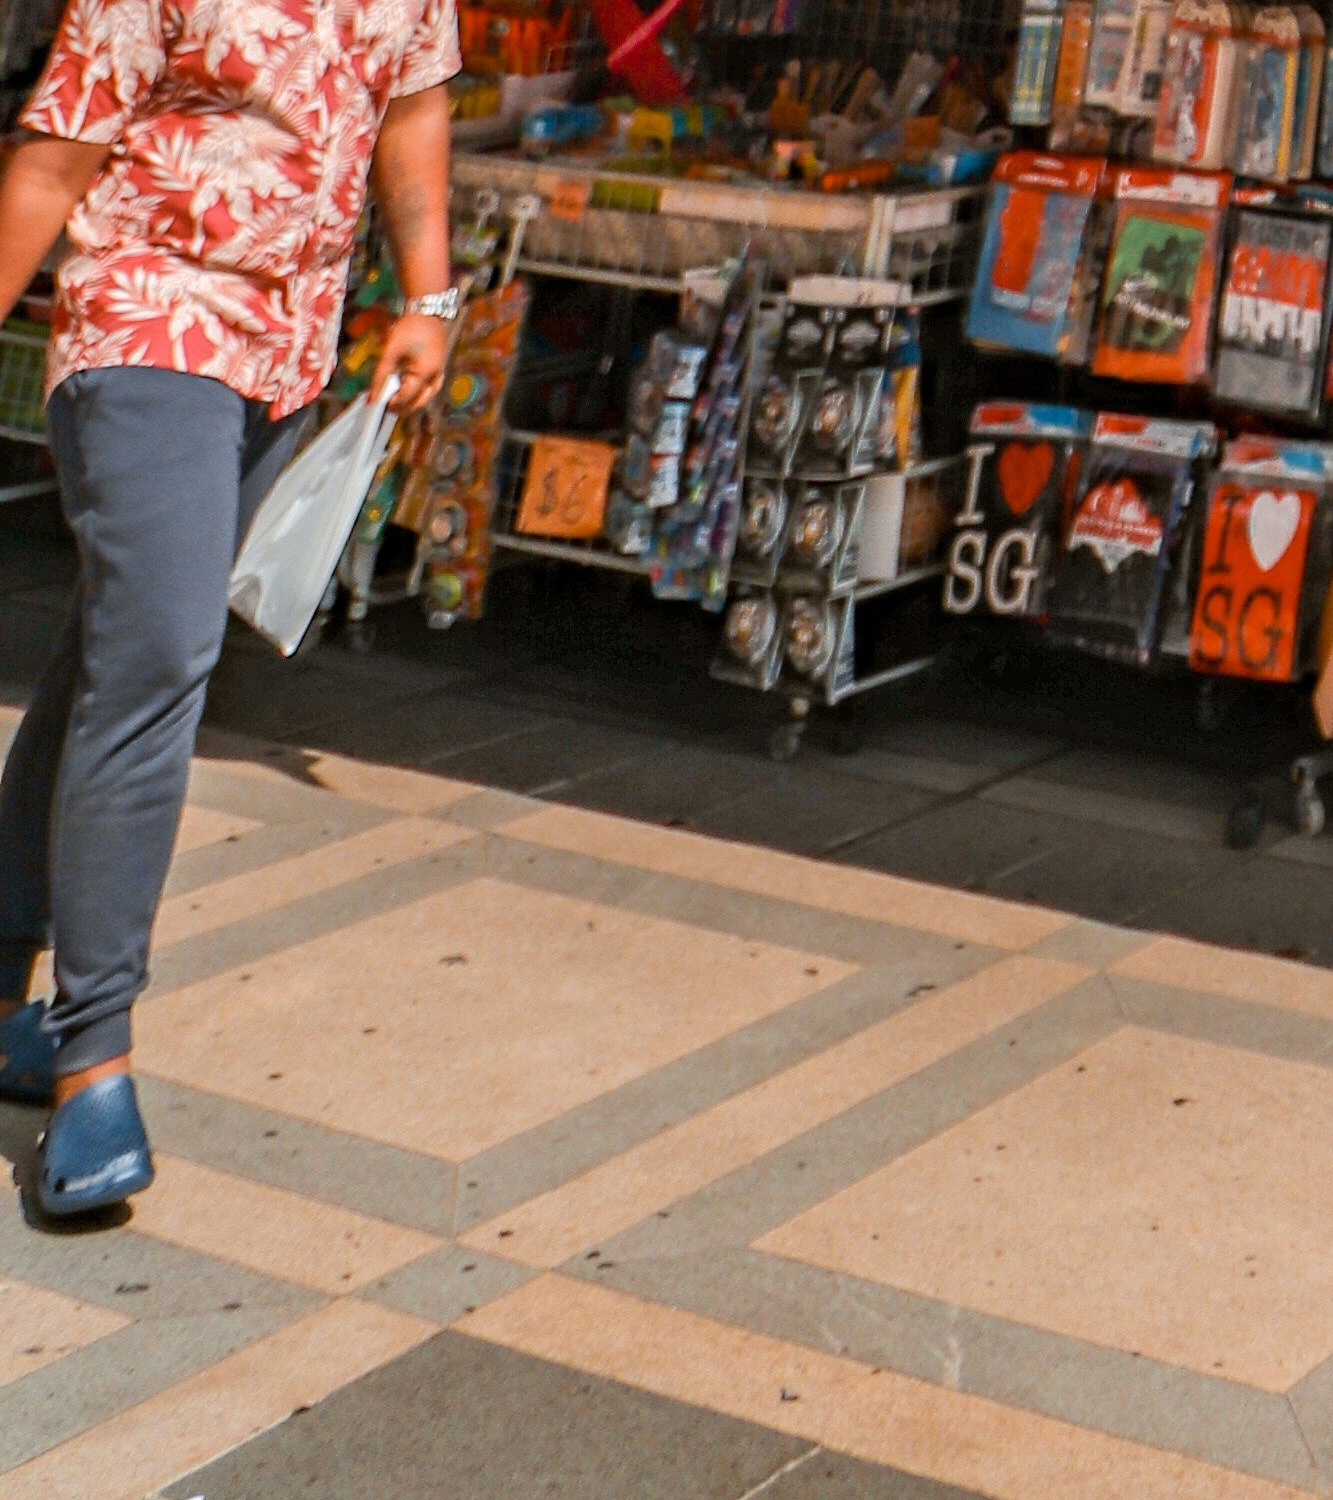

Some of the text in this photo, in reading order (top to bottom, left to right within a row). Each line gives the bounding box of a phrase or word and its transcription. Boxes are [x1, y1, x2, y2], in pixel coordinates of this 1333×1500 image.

[953, 443, 996, 527] I
[943, 527, 1040, 616] SG
[1195, 585, 1284, 671] SG
